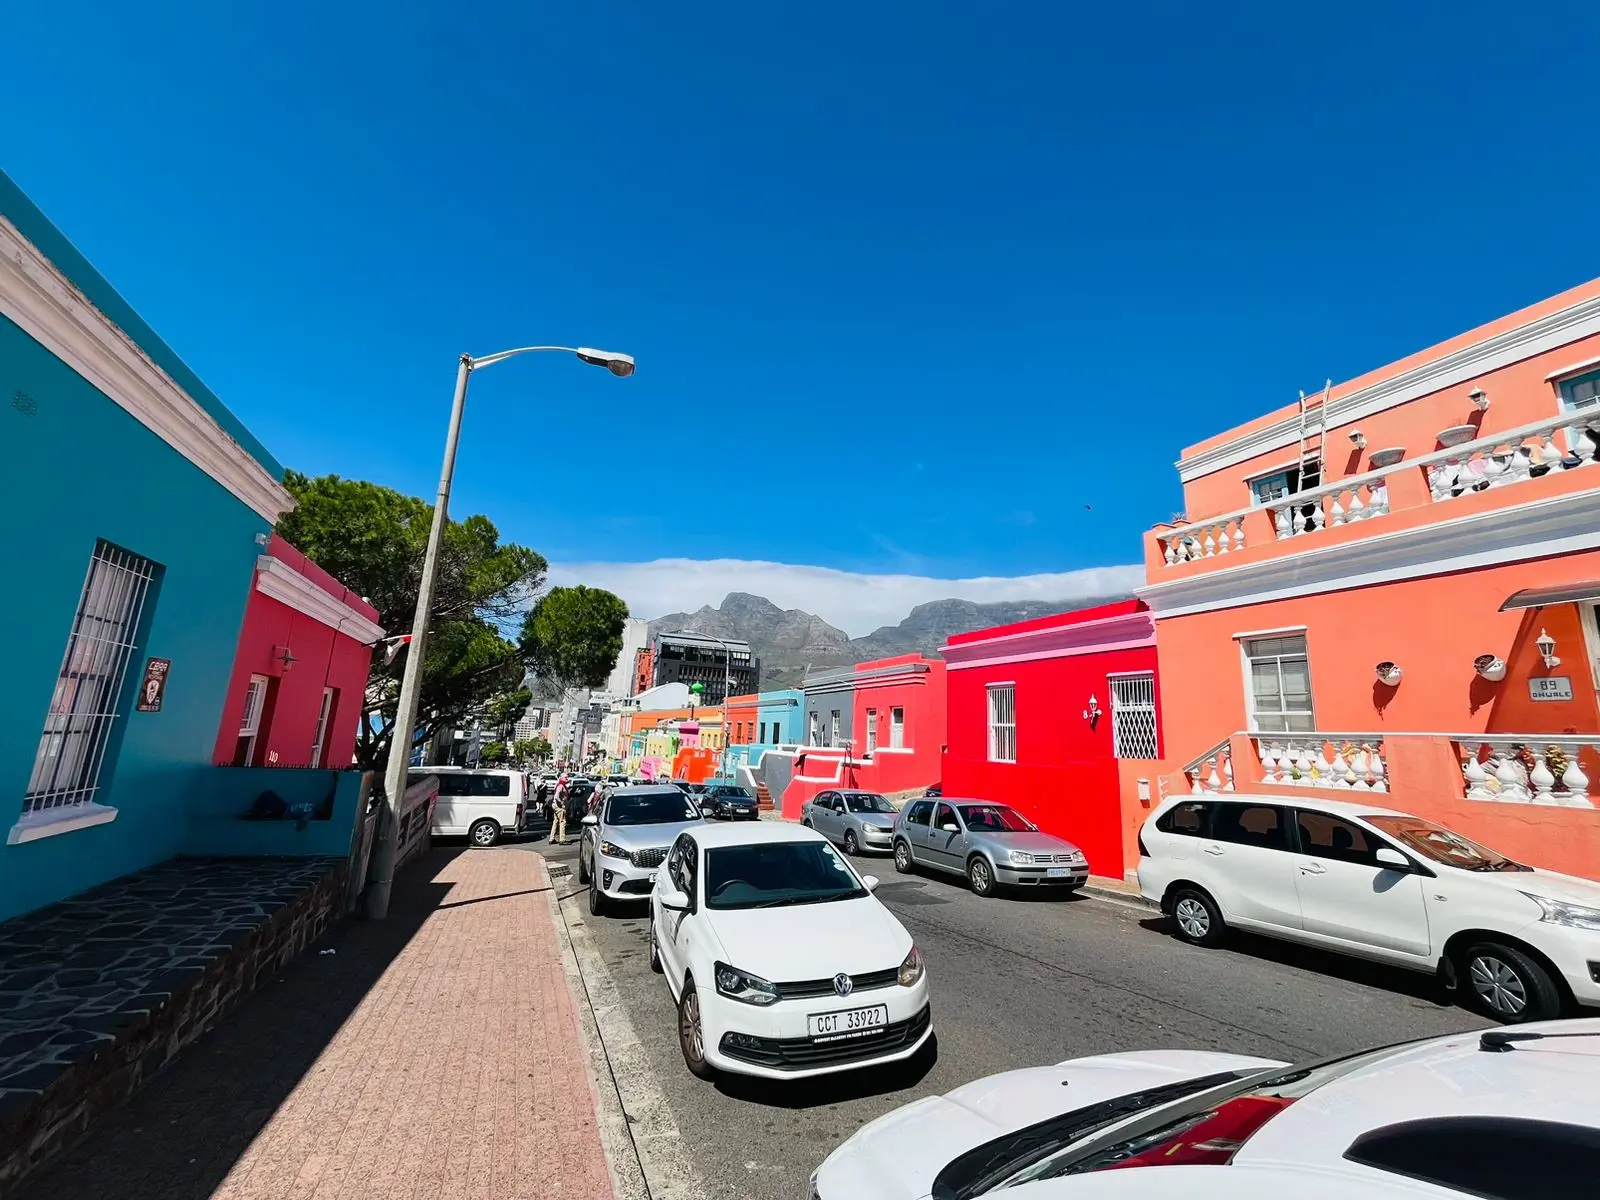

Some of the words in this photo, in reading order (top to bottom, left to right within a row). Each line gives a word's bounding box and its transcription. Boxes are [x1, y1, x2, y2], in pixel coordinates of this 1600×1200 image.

[1540, 680, 1557, 690] 89
[817, 1015, 838, 1032] CCT
[847, 1008, 880, 1028] 33922
